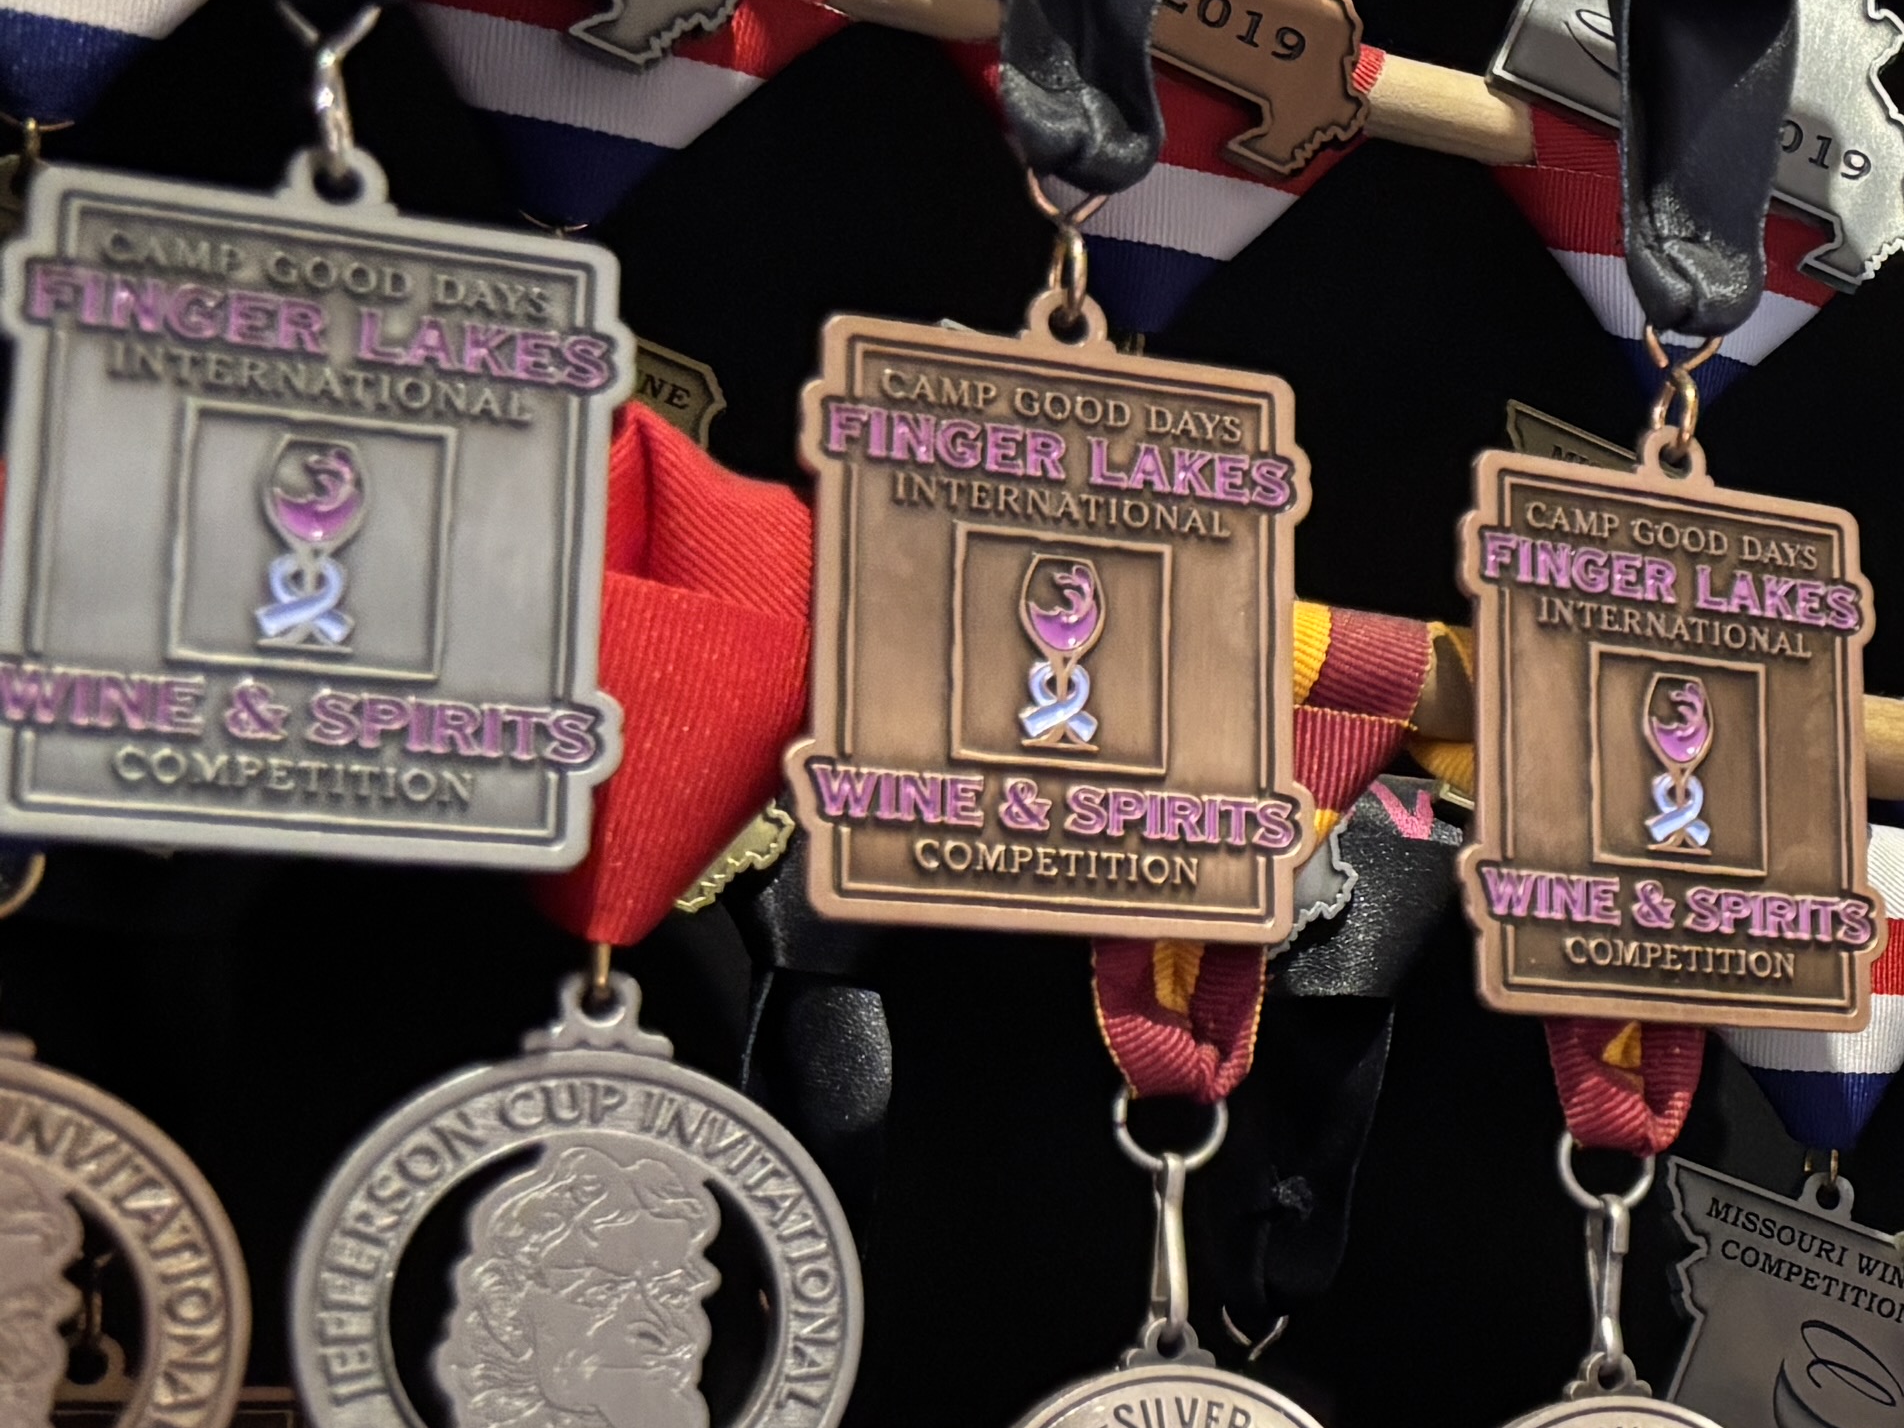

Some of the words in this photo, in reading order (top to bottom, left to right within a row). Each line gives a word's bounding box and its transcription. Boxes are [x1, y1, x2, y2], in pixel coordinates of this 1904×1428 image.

[103, 227, 241, 278] CAMP
[266, 247, 412, 299] GOOD
[434, 274, 552, 317] DAYS
[25, 261, 324, 356] FINGER
[359, 313, 611, 392] LAKES
[111, 339, 533, 425] INTERNATIONAL
[882, 369, 998, 411] CAMP
[1014, 386, 1130, 428] GOOD
[1149, 404, 1242, 444] DAYS
[825, 401, 1064, 480] FINGER
[1089, 436, 1292, 508] LAKES
[892, 472, 1230, 538] INTERNATIONAL
[0, 660, 205, 736] WINE
[225, 677, 289, 741] &
[307, 686, 600, 764] SPIRITS
[113, 743, 473, 810] COMPETITION
[812, 764, 984, 828] WINE
[1000, 780, 1050, 831] &
[1062, 786, 1300, 848] SPIRITS
[912, 838, 1200, 888] COMPETITION
[317, 1109, 492, 1403] JEFFERSON
[496, 1081, 623, 1133] CUP
[642, 1088, 840, 1408] INVITATIONAL
